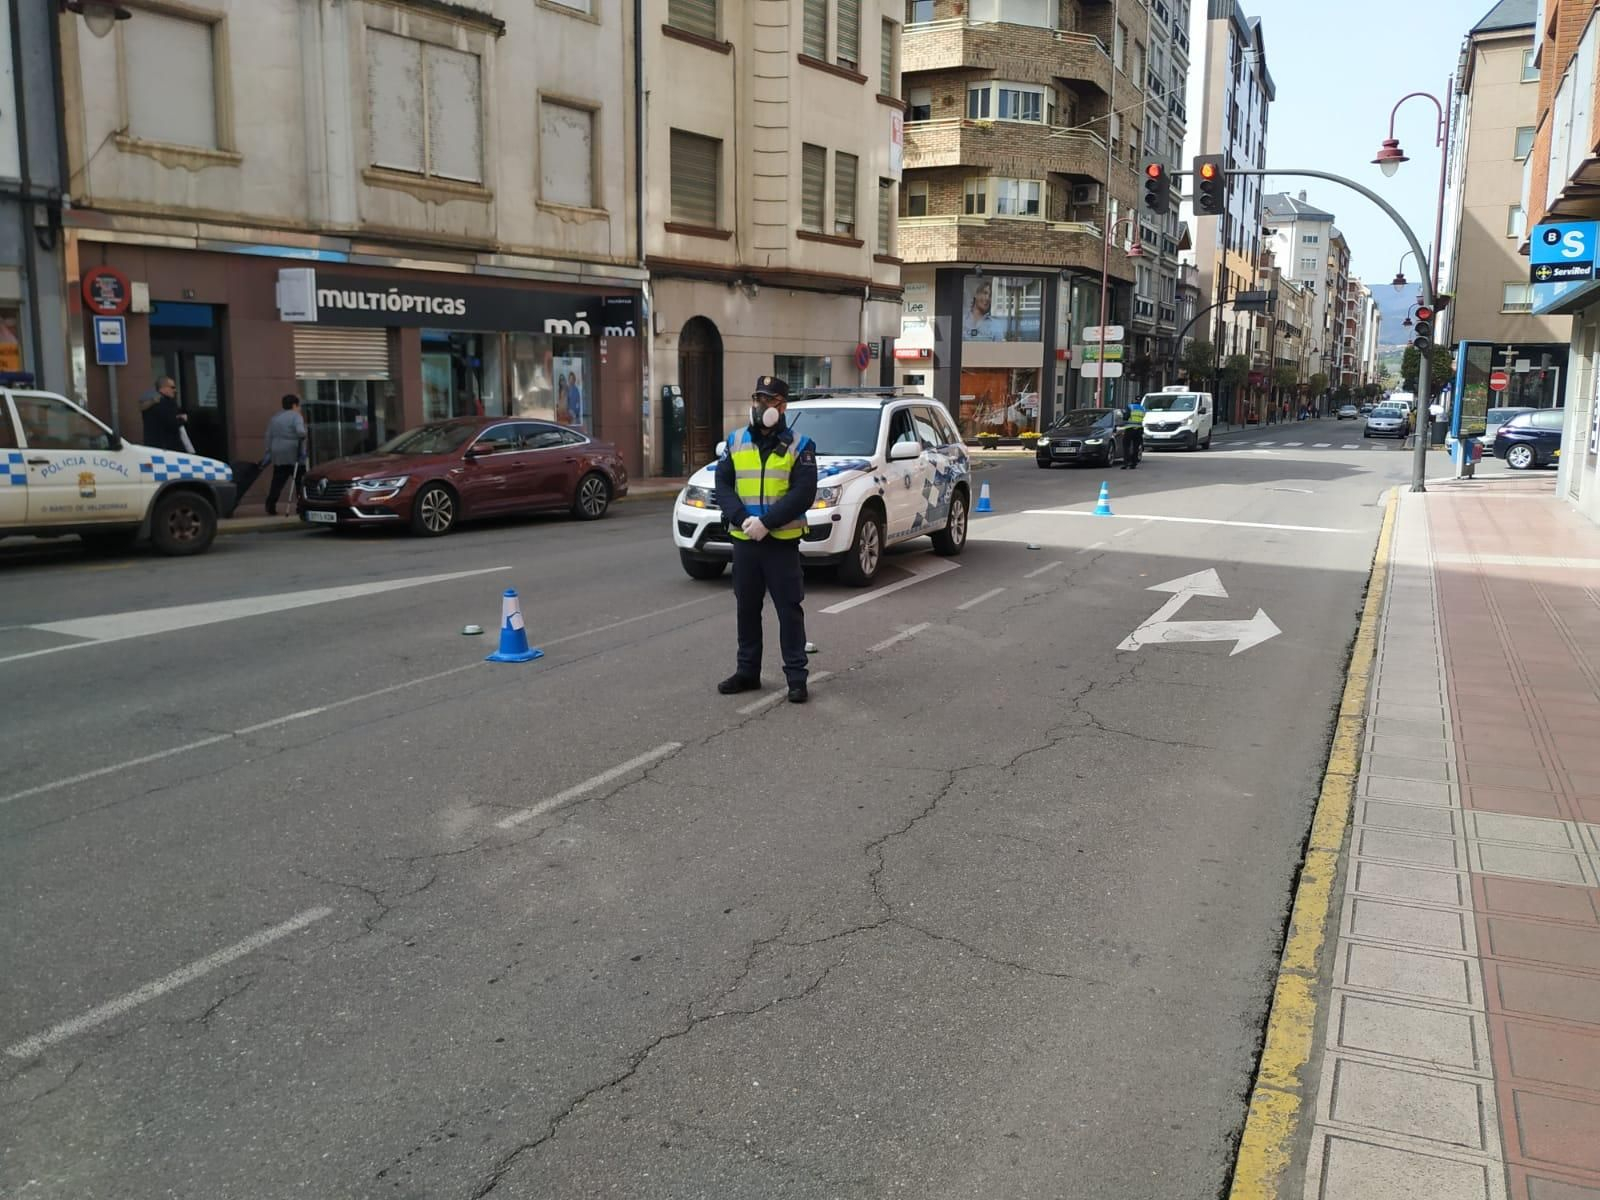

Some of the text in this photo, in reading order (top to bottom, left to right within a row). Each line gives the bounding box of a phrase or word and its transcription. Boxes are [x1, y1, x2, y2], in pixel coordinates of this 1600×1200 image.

[1547, 230, 1585, 258] B S
[1553, 266, 1592, 276] ServiRed
[907, 303, 924, 312] Lee
[93, 457, 129, 477] LOCAL
